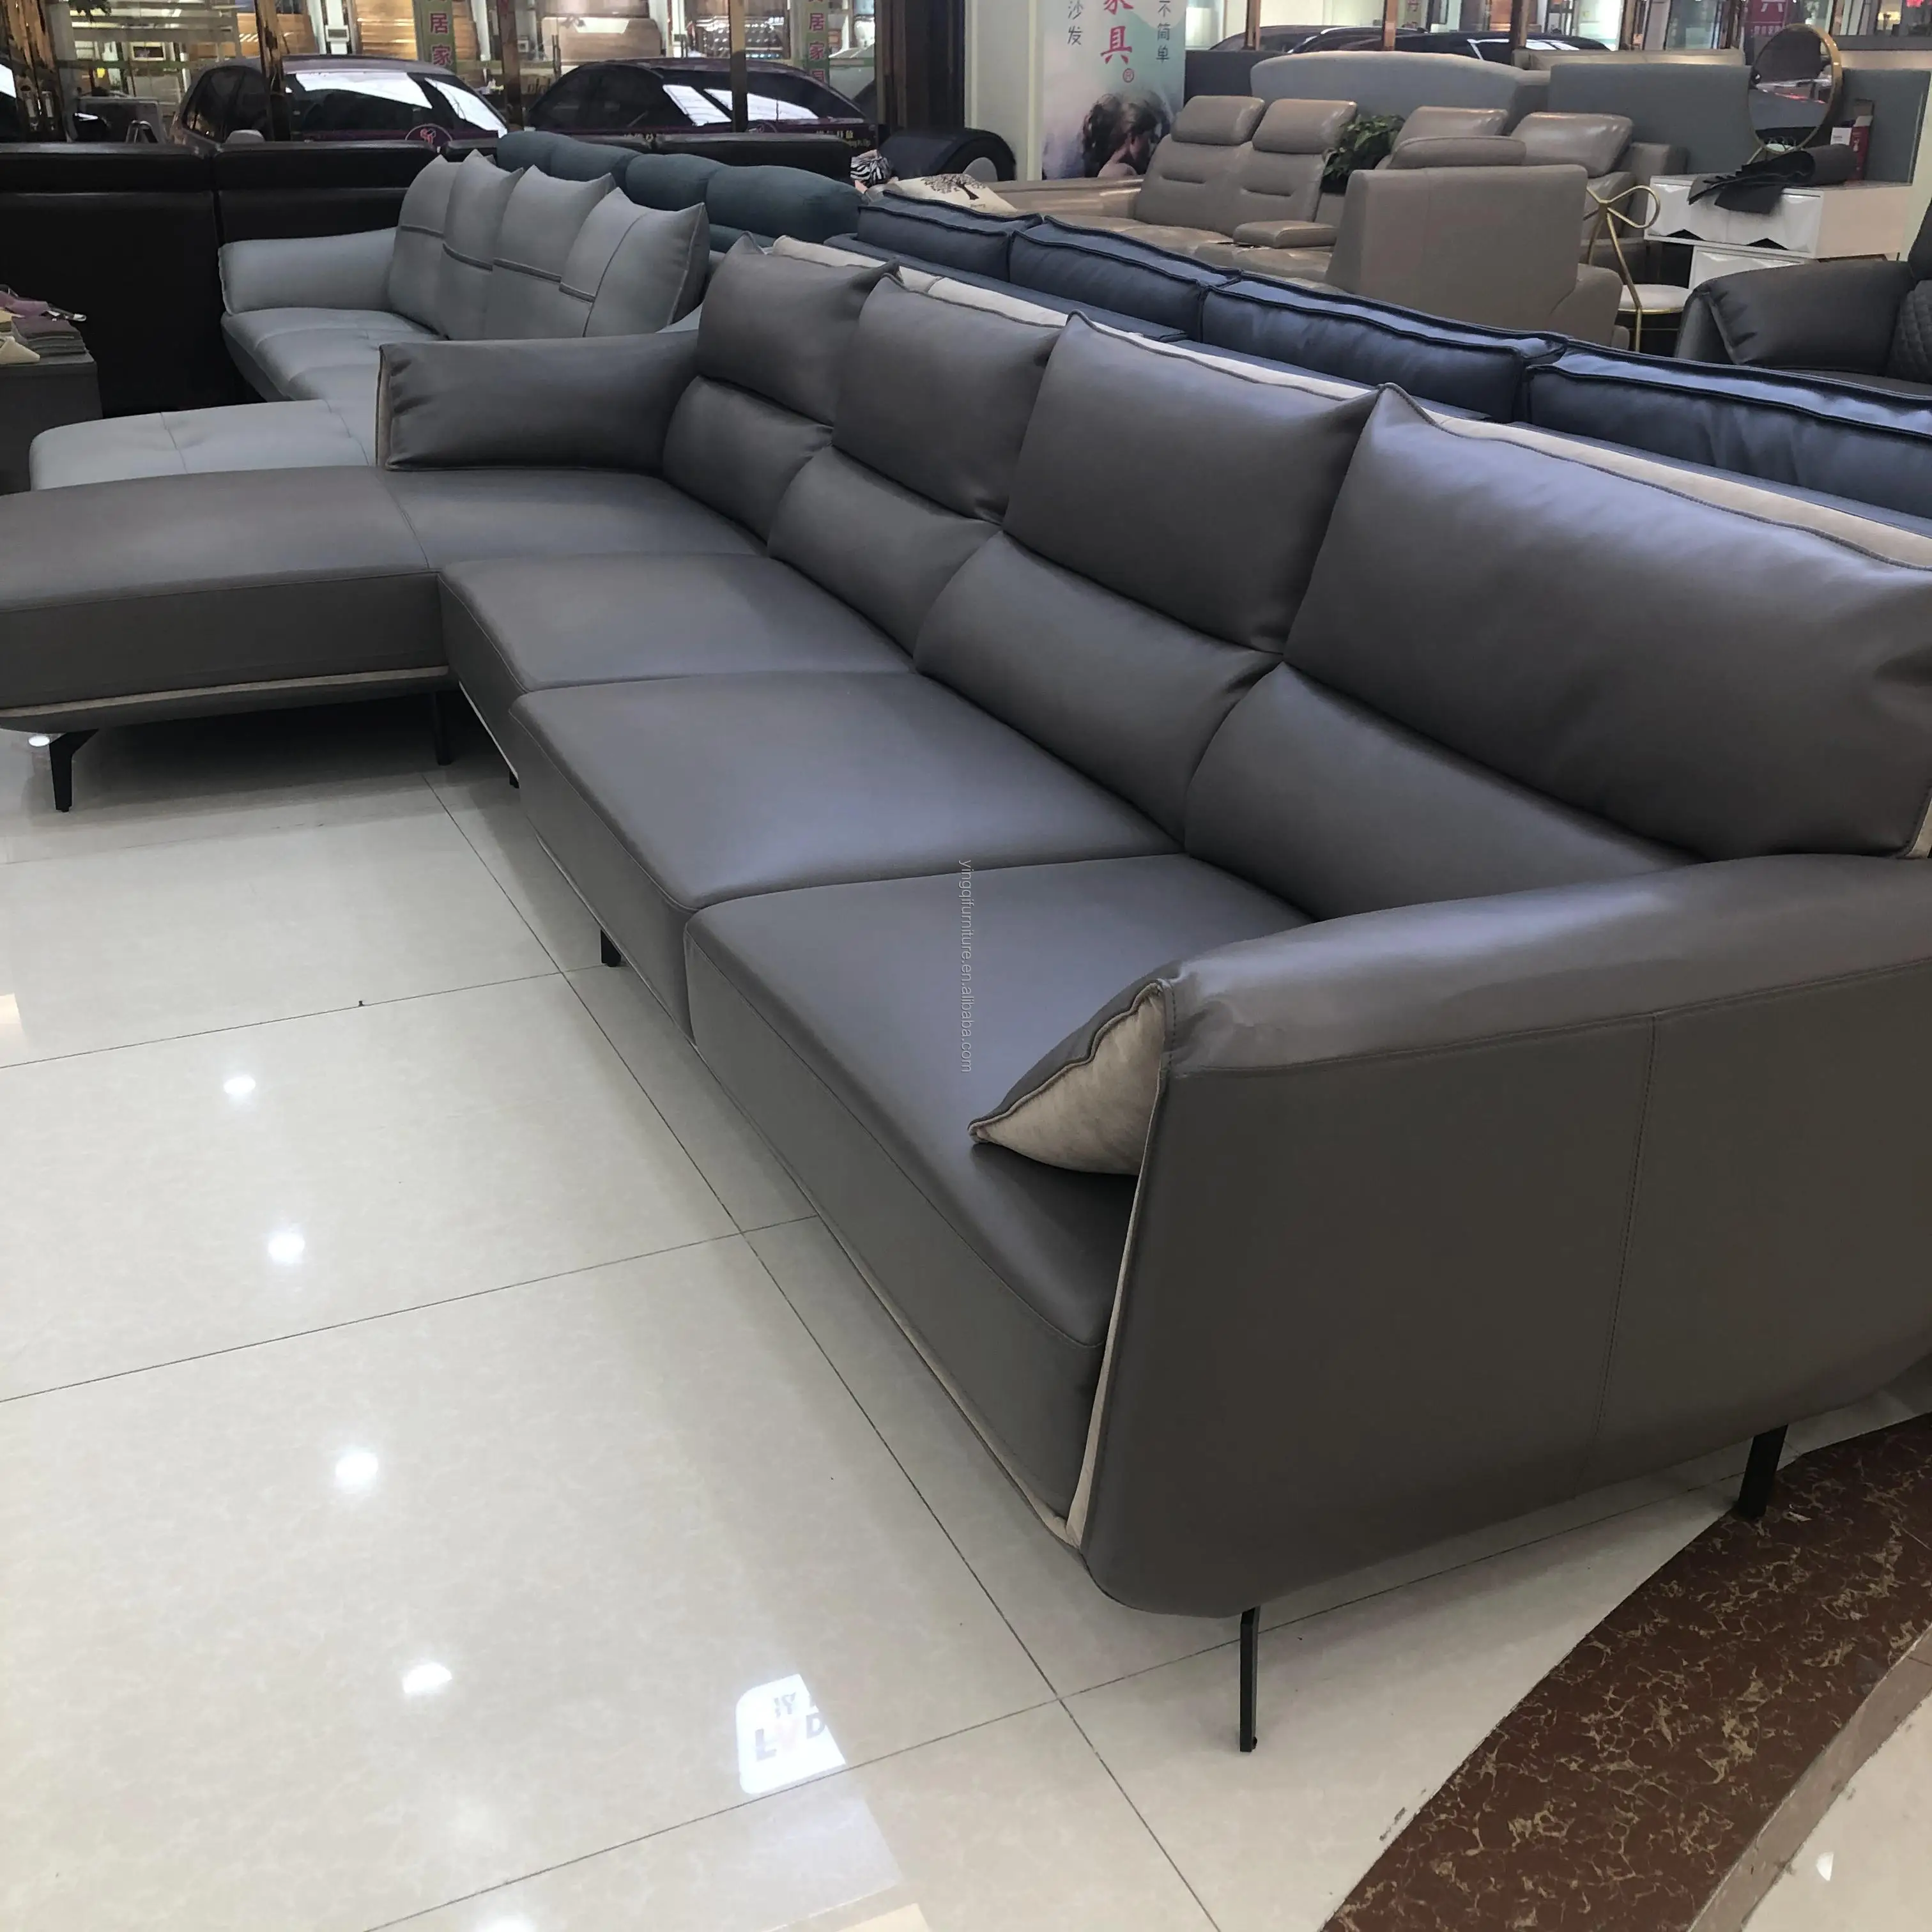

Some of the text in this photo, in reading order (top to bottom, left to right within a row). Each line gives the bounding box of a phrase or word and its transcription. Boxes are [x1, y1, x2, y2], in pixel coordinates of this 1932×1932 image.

[430, 0, 451, 64] 居家
[1156, 0, 1171, 63] 不简单
